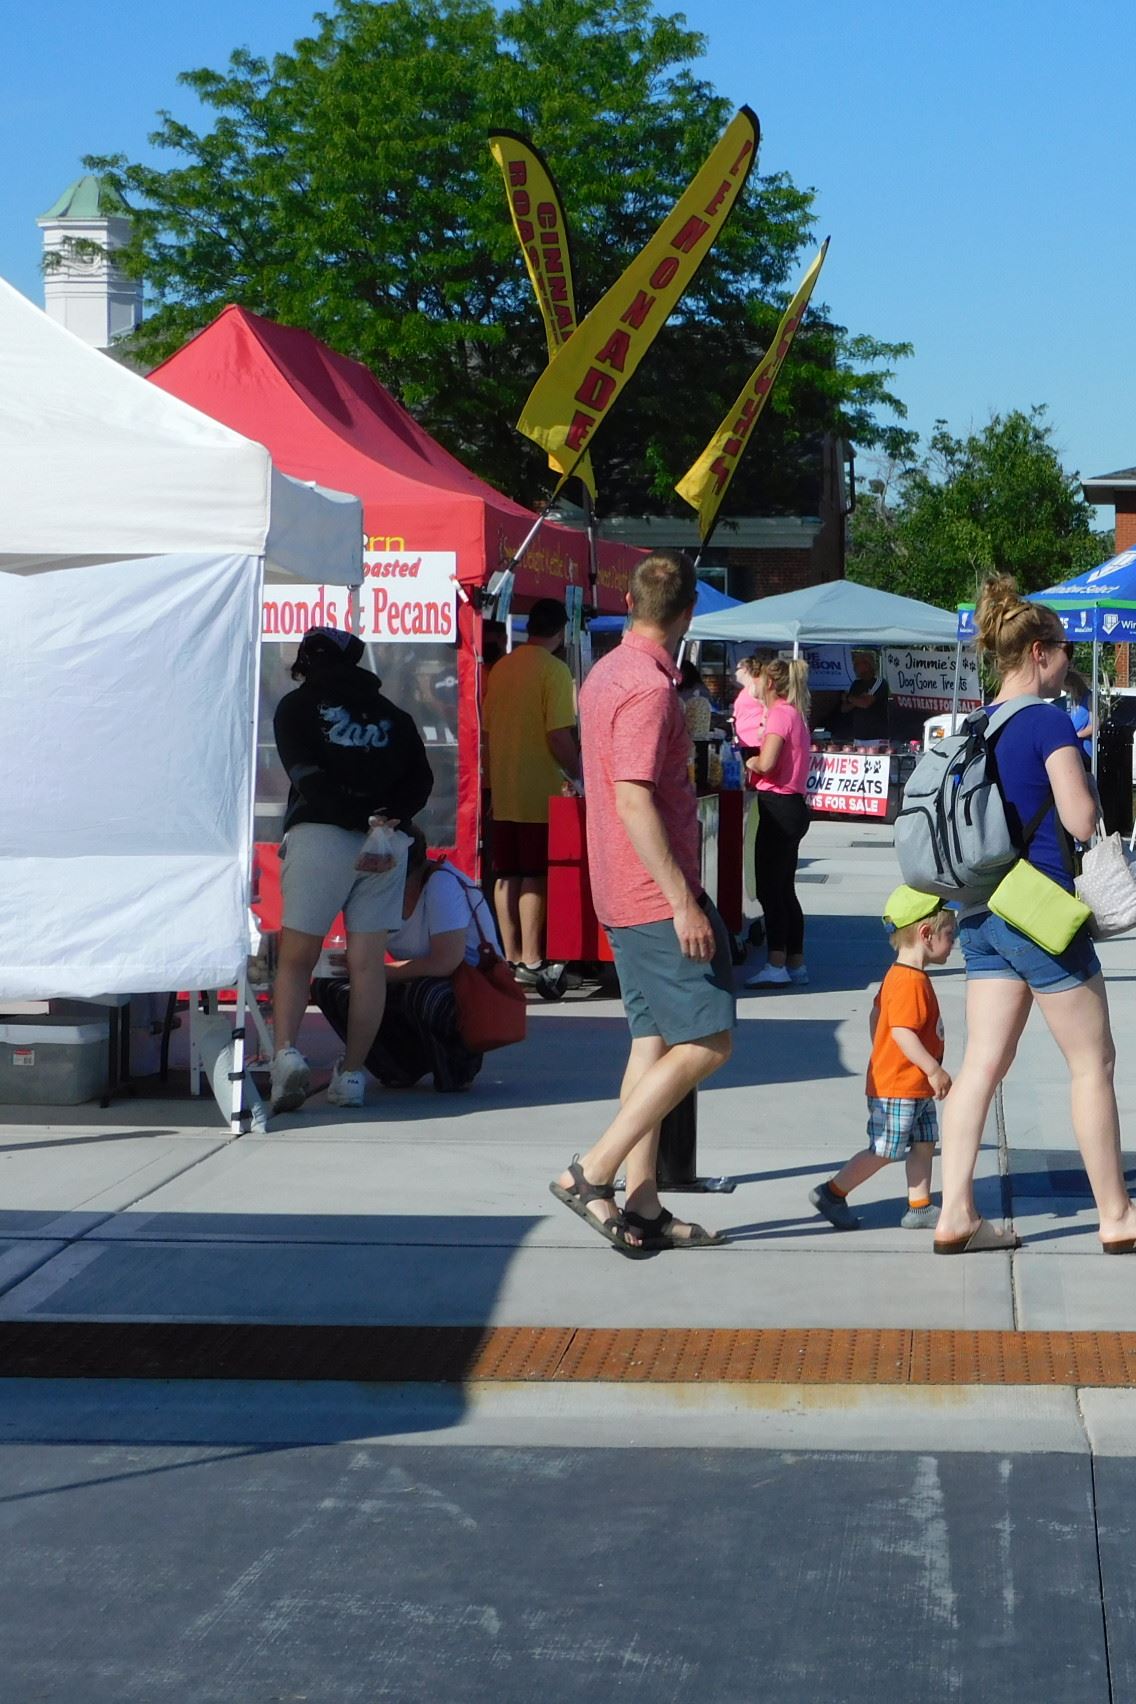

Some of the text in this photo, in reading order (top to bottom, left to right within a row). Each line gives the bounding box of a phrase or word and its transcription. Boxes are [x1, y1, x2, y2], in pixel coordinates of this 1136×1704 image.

[564, 139, 753, 453] LEMONADE
[372, 588, 452, 635] Pecans
[905, 652, 957, 671] Jimmie's
[940, 674, 968, 691] Trets
[912, 698, 938, 711] TREATS
[808, 757, 859, 775] MMIE'S
[837, 778, 882, 795] TREATS
[825, 796, 847, 810] FOR
[849, 798, 878, 813] SALE
